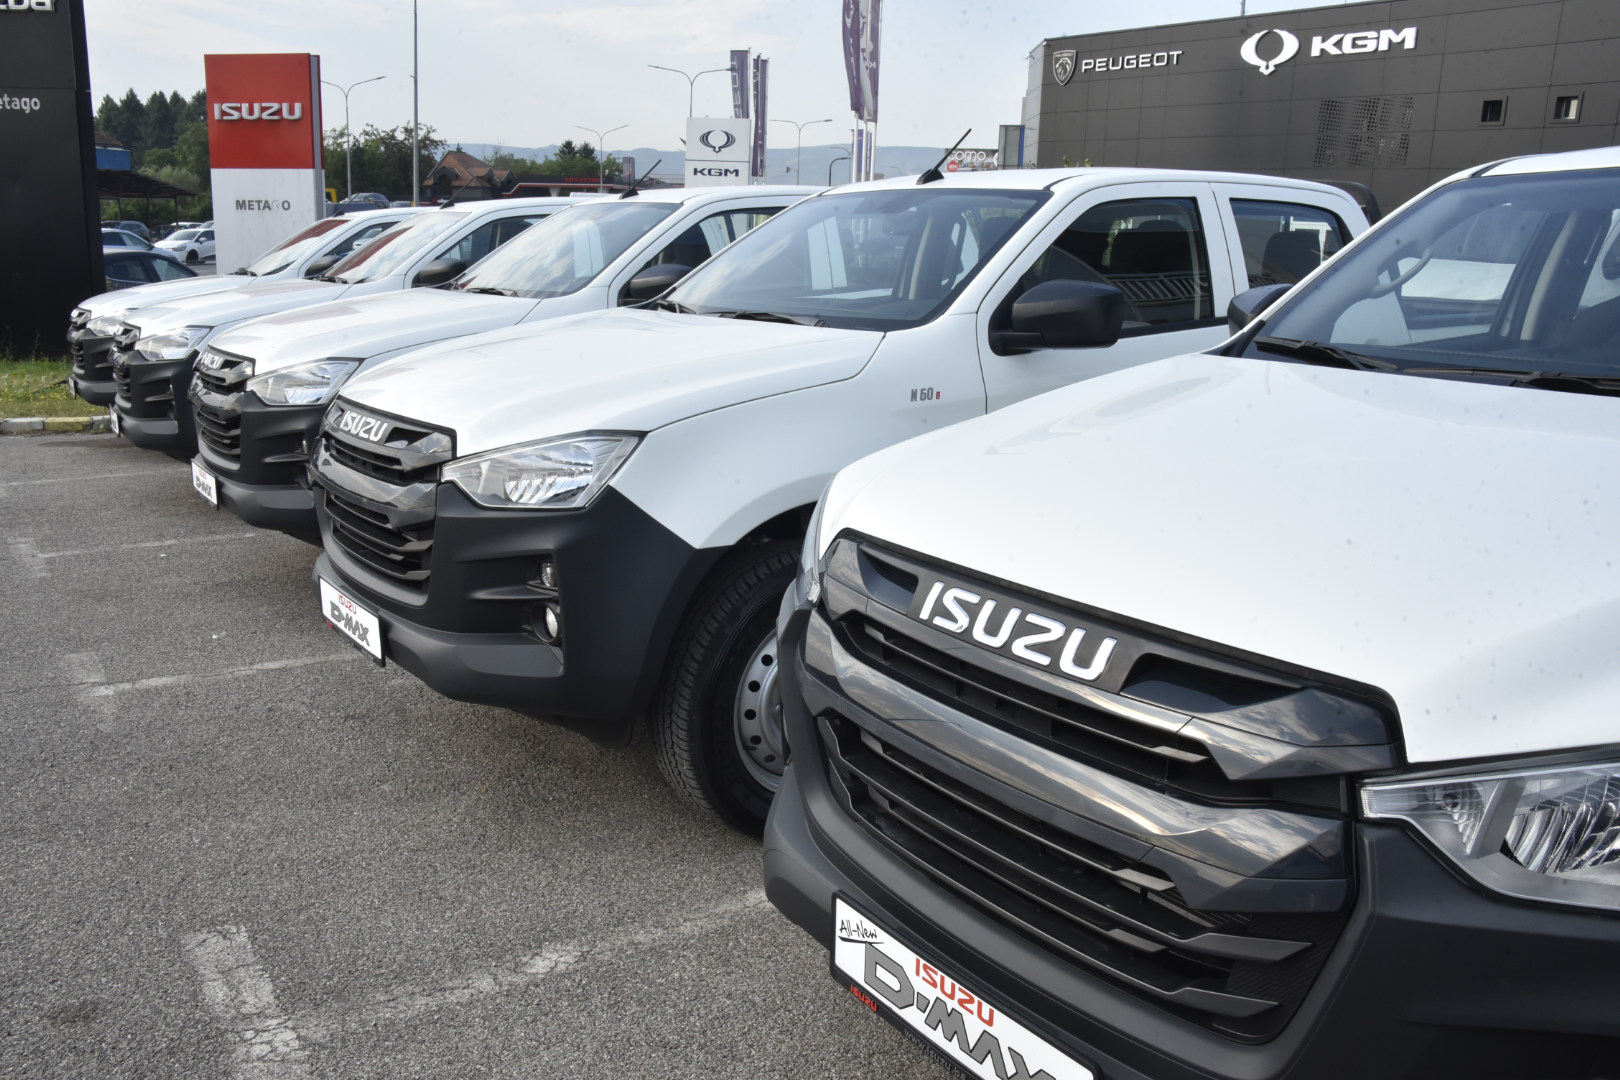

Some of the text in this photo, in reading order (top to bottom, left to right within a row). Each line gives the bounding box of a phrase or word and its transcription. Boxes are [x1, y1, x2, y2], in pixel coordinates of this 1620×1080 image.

[1310, 27, 1417, 57] KGM
[1081, 51, 1182, 73] PEUGEOT
[213, 102, 303, 121] ISUZU
[693, 167, 740, 178] KGM
[340, 410, 389, 442] ISUZU
[919, 581, 1118, 681] ISUZU
[839, 919, 878, 940] All-New
[850, 984, 879, 1013] ISUZU
[915, 957, 995, 1028] ISUZU
